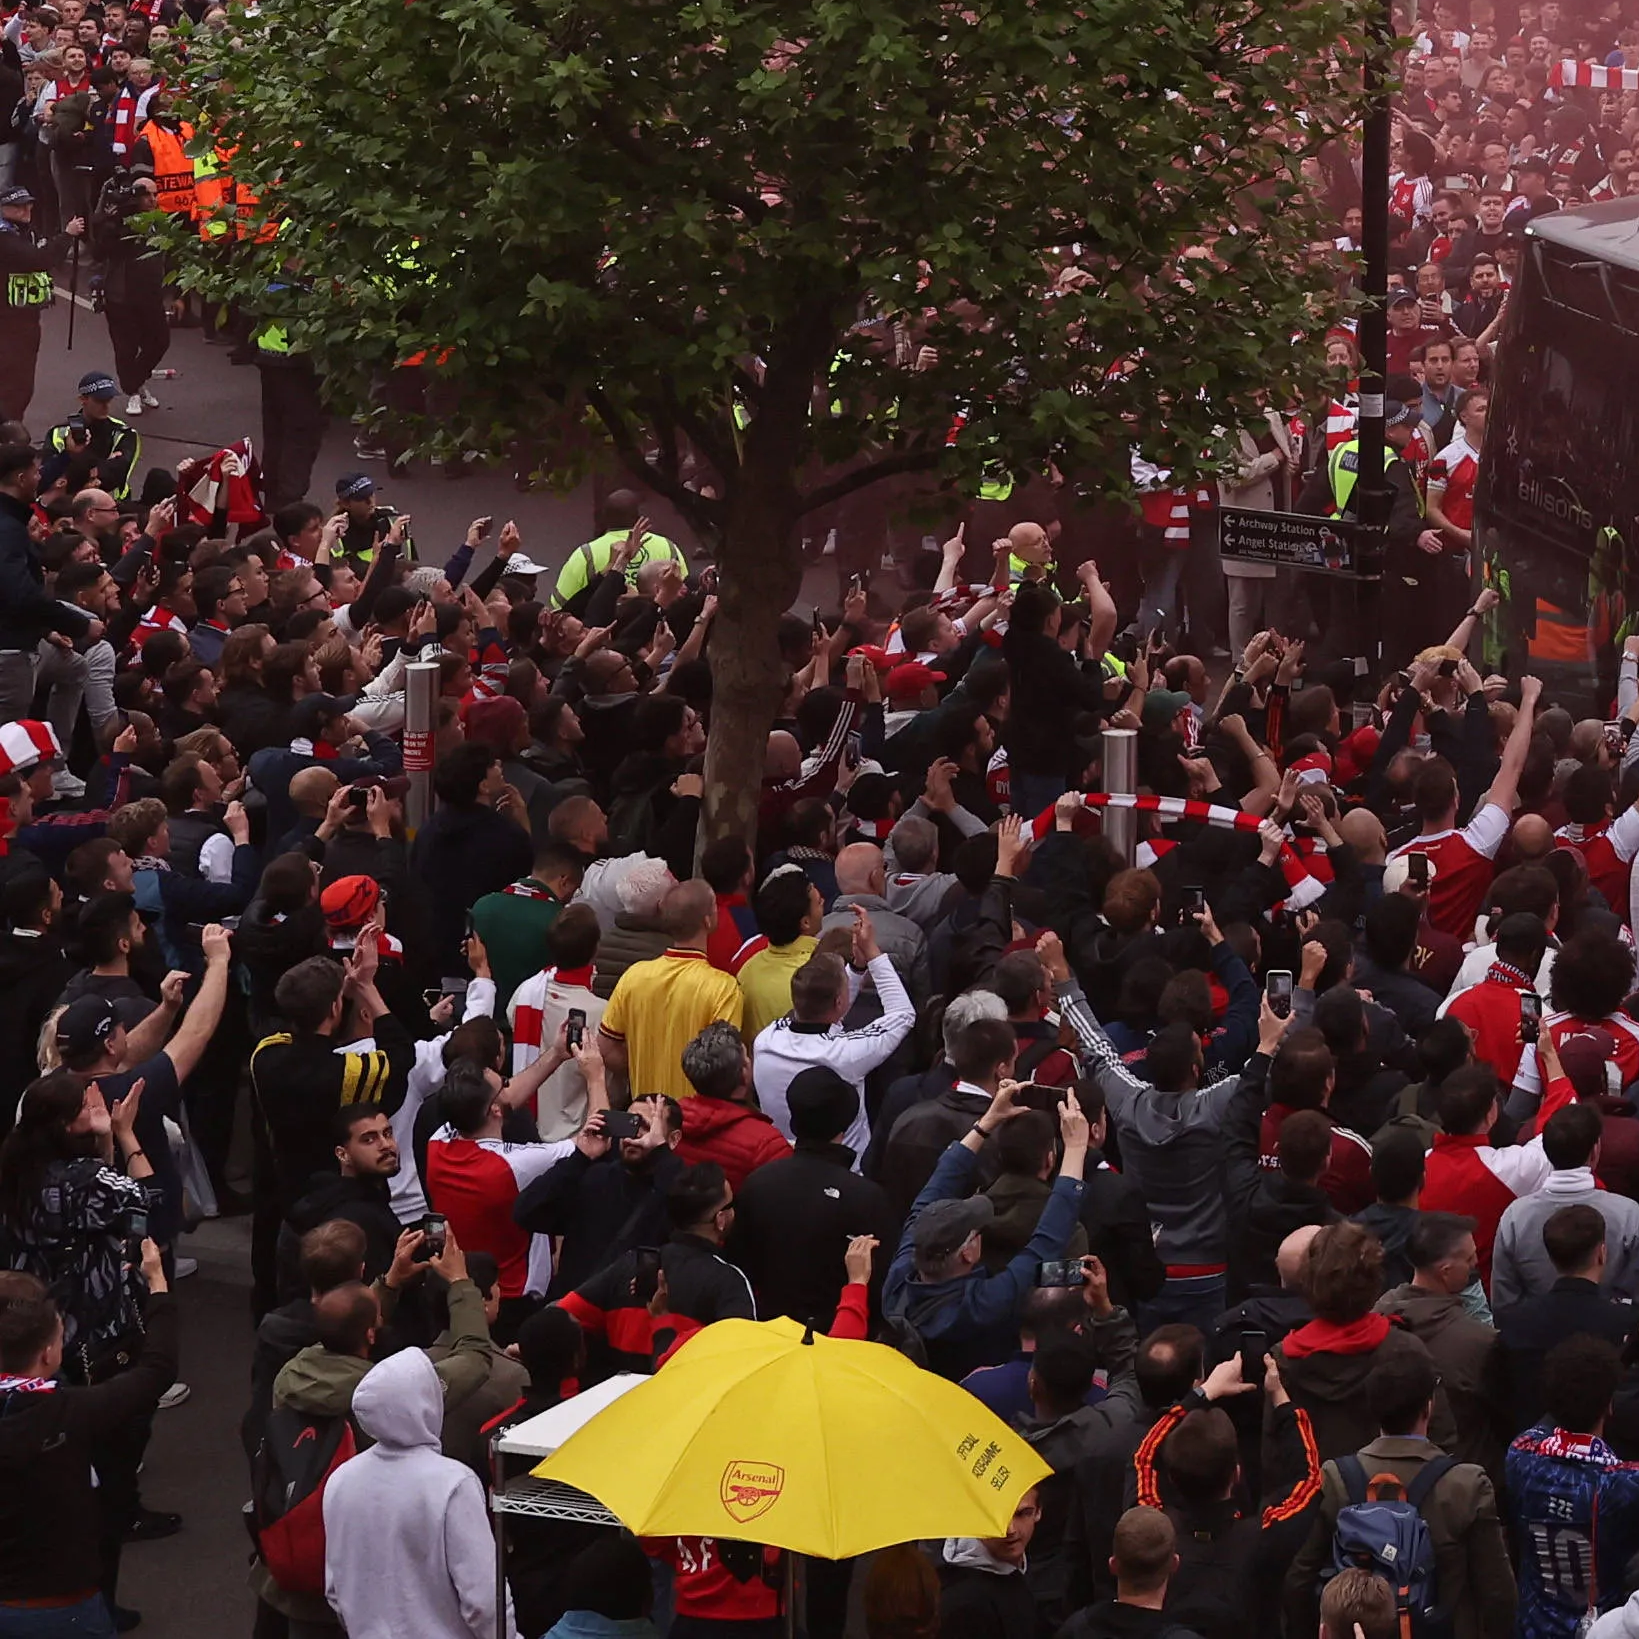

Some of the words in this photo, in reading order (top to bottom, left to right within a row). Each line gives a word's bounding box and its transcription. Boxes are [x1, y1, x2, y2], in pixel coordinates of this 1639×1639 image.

[1238, 514, 1279, 533] Archway
[1281, 521, 1315, 537] Station
[1238, 534, 1266, 549] Angel
[732, 1469, 776, 1485] Arsenal
